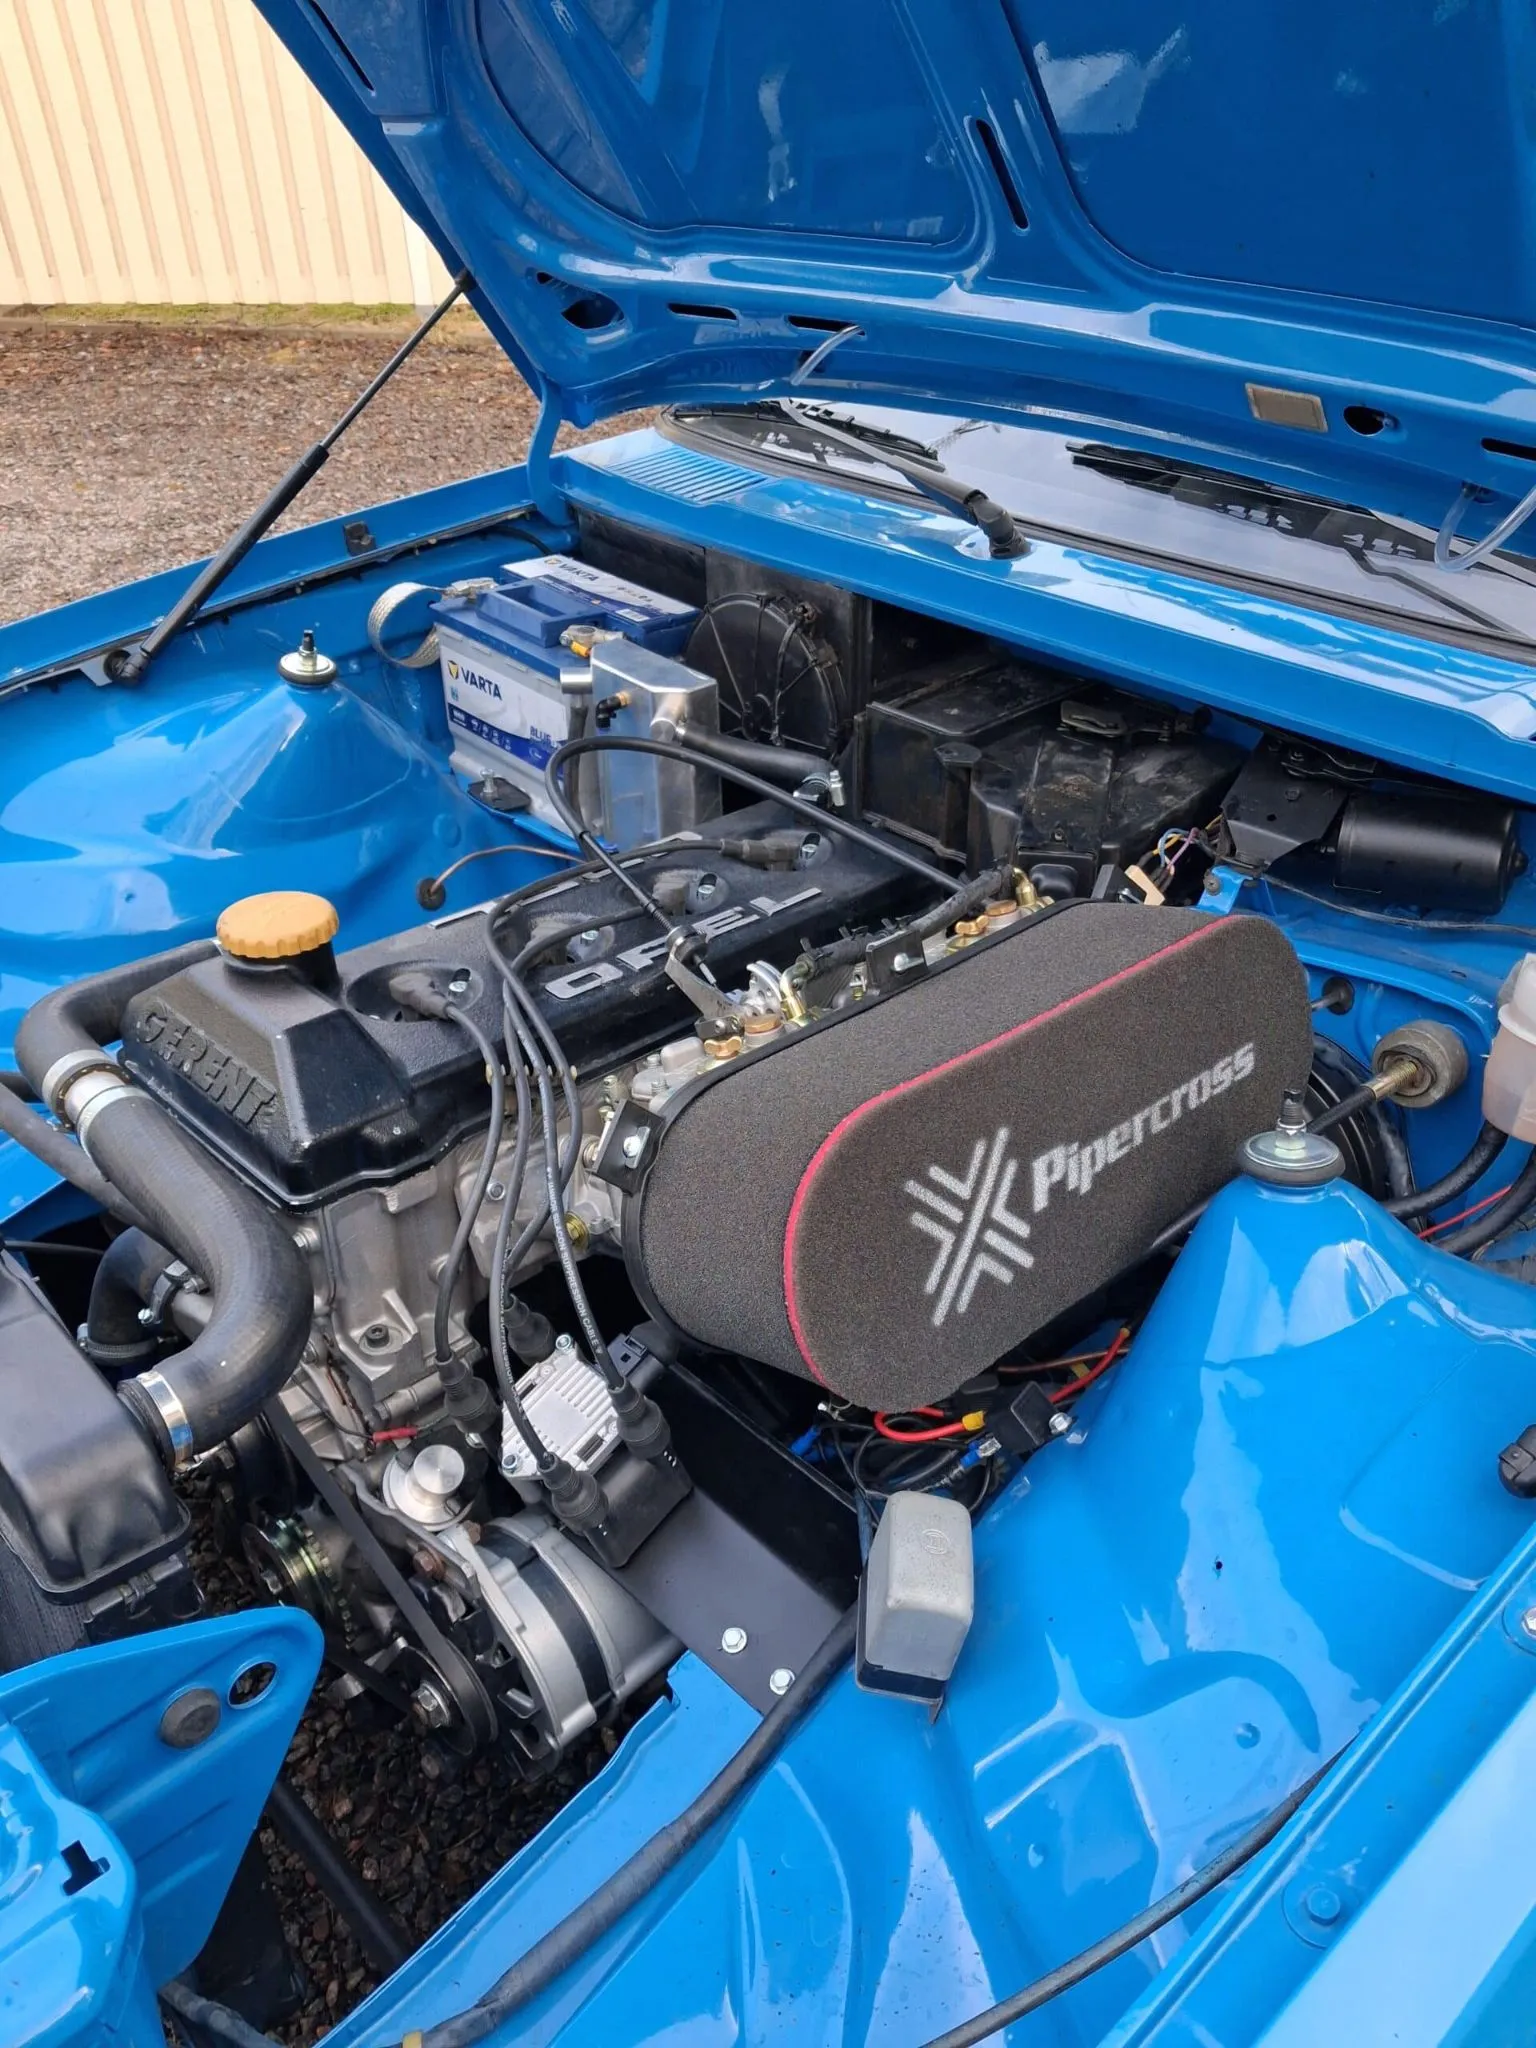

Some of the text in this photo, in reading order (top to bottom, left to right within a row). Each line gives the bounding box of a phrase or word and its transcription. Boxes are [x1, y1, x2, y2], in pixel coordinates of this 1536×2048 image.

[460, 667, 503, 701] VARTA
[1030, 1042, 1256, 1213] Pipercross
[559, 1250, 588, 1317] SUPPRESSION
[581, 1316, 600, 1346] CABLE
